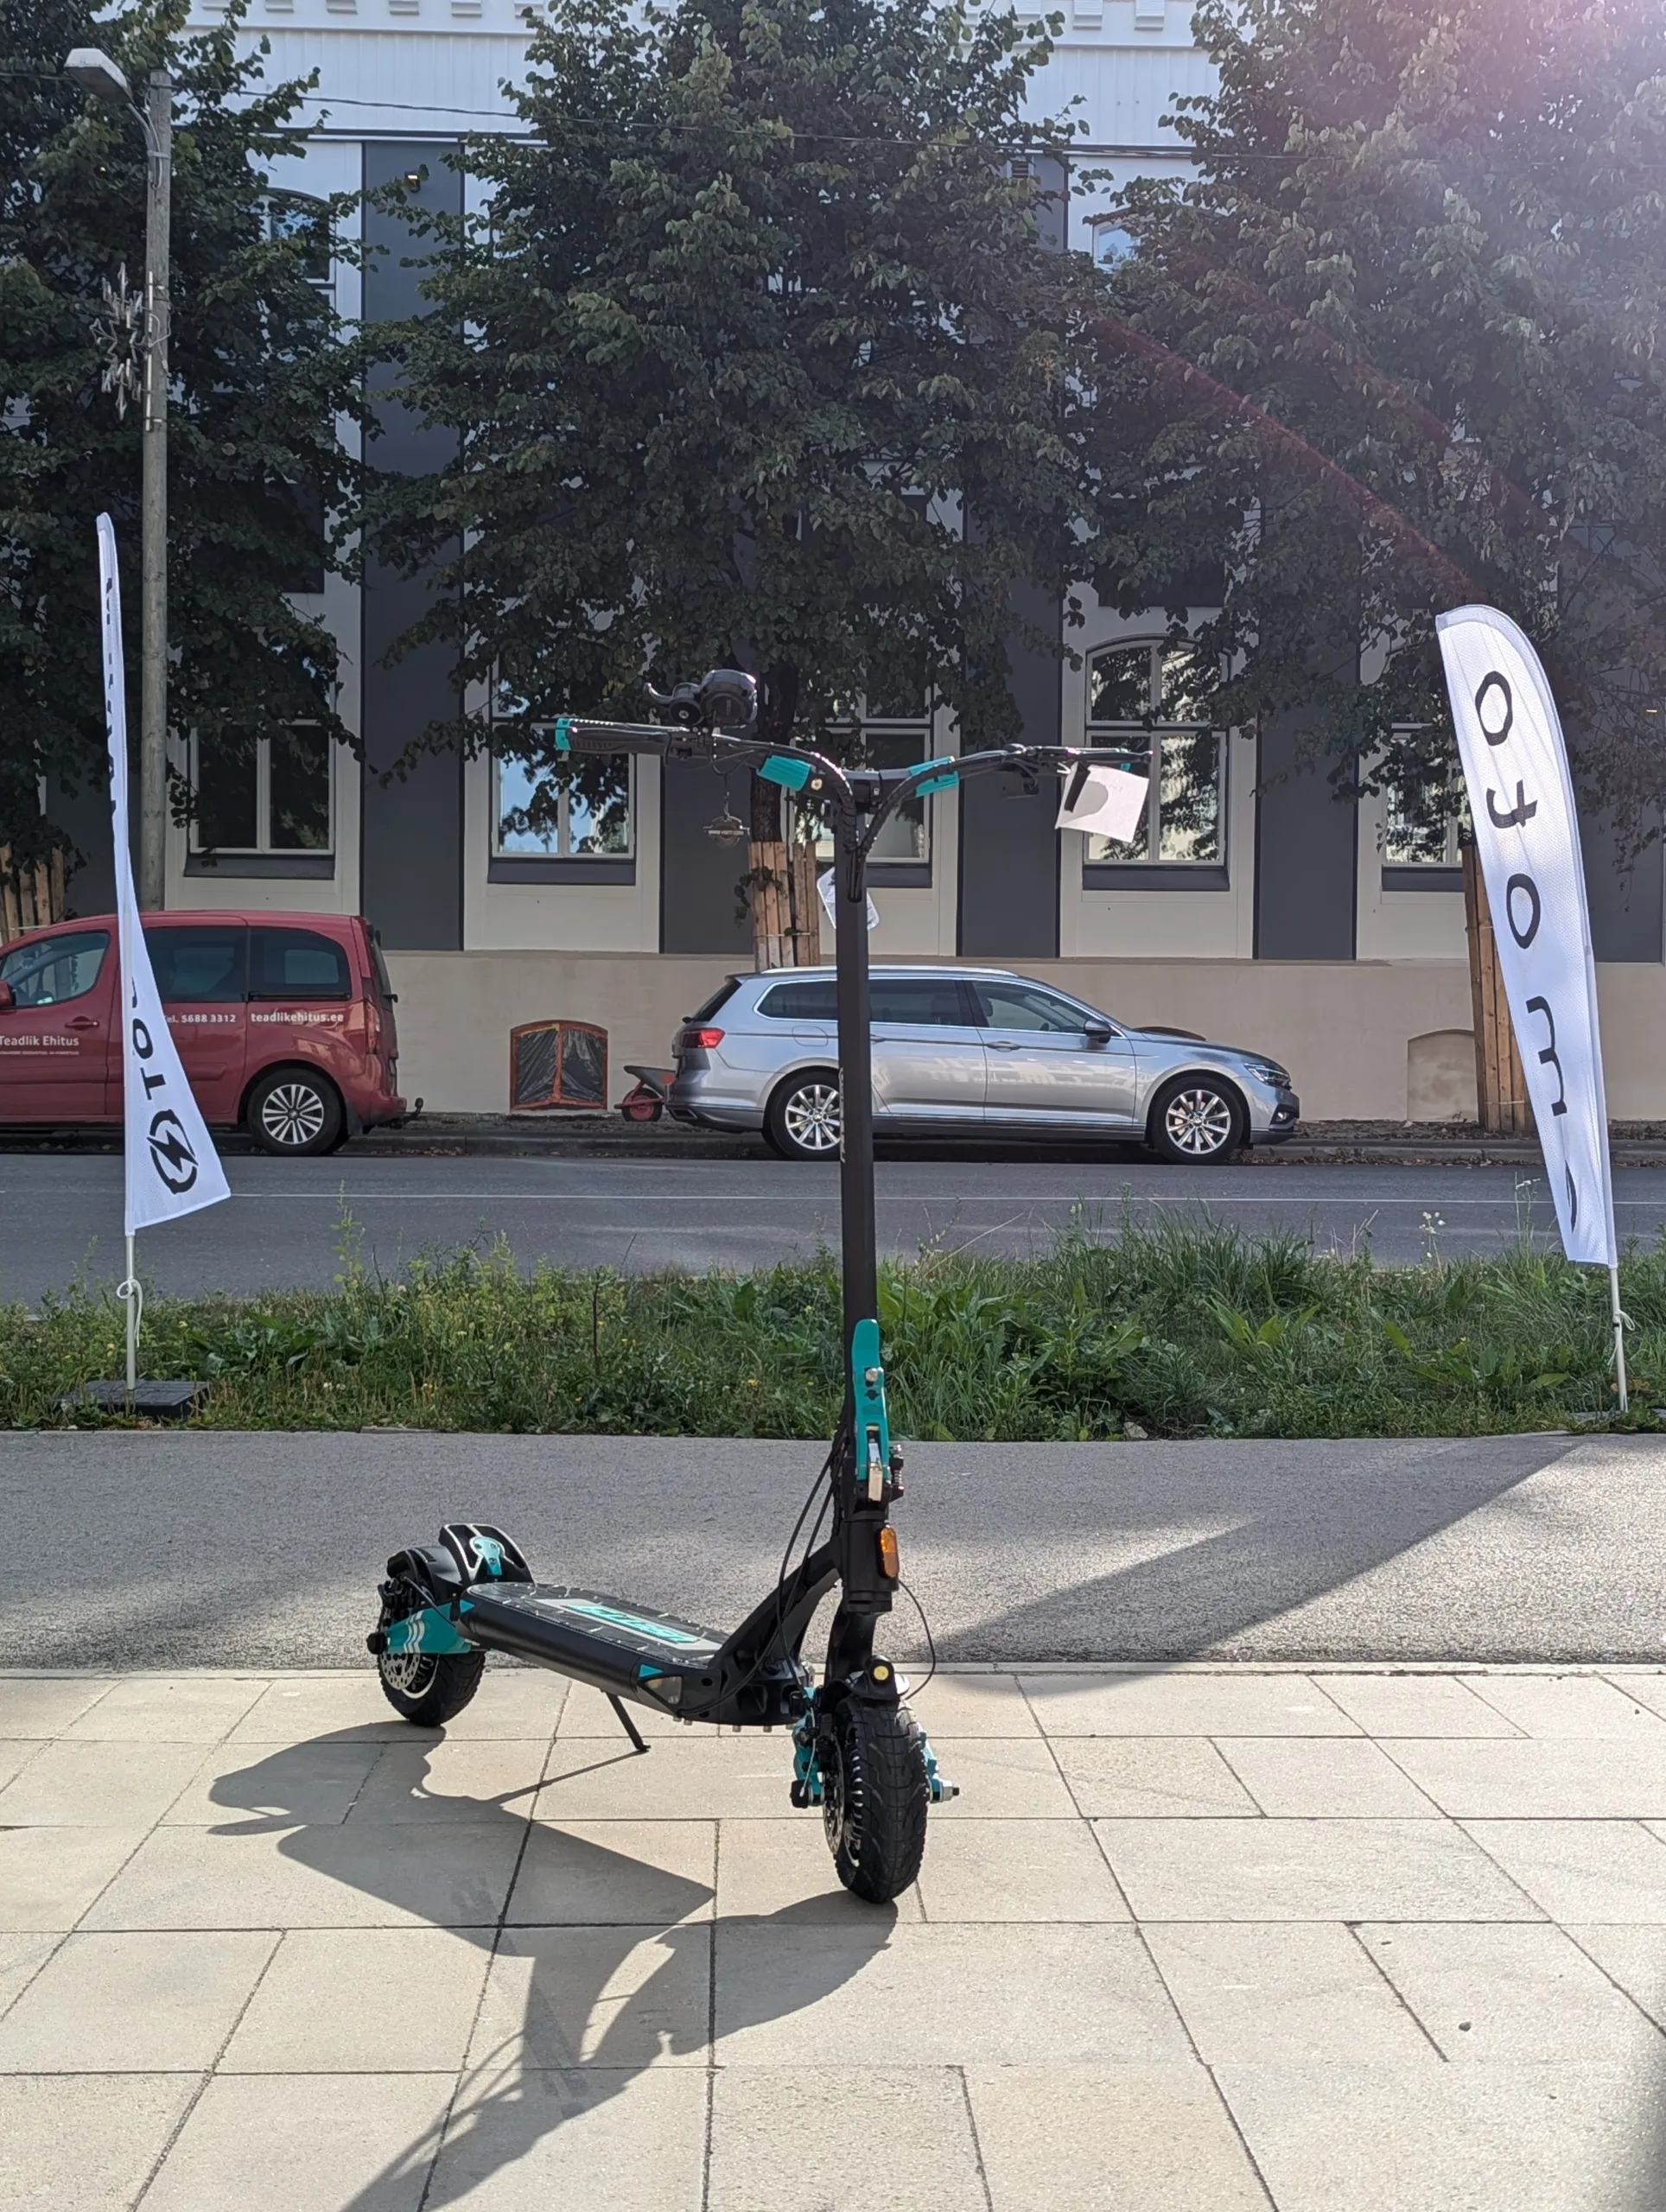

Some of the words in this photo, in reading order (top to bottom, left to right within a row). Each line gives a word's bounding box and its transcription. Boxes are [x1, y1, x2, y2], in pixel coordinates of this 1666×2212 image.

[164, 1014, 179, 1023] el.
[181, 1014, 207, 1023] 5688
[210, 1014, 236, 1023] 3312
[251, 1011, 344, 1022] teadlikehitus.ee
[42, 1035, 79, 1046] Ehitus
